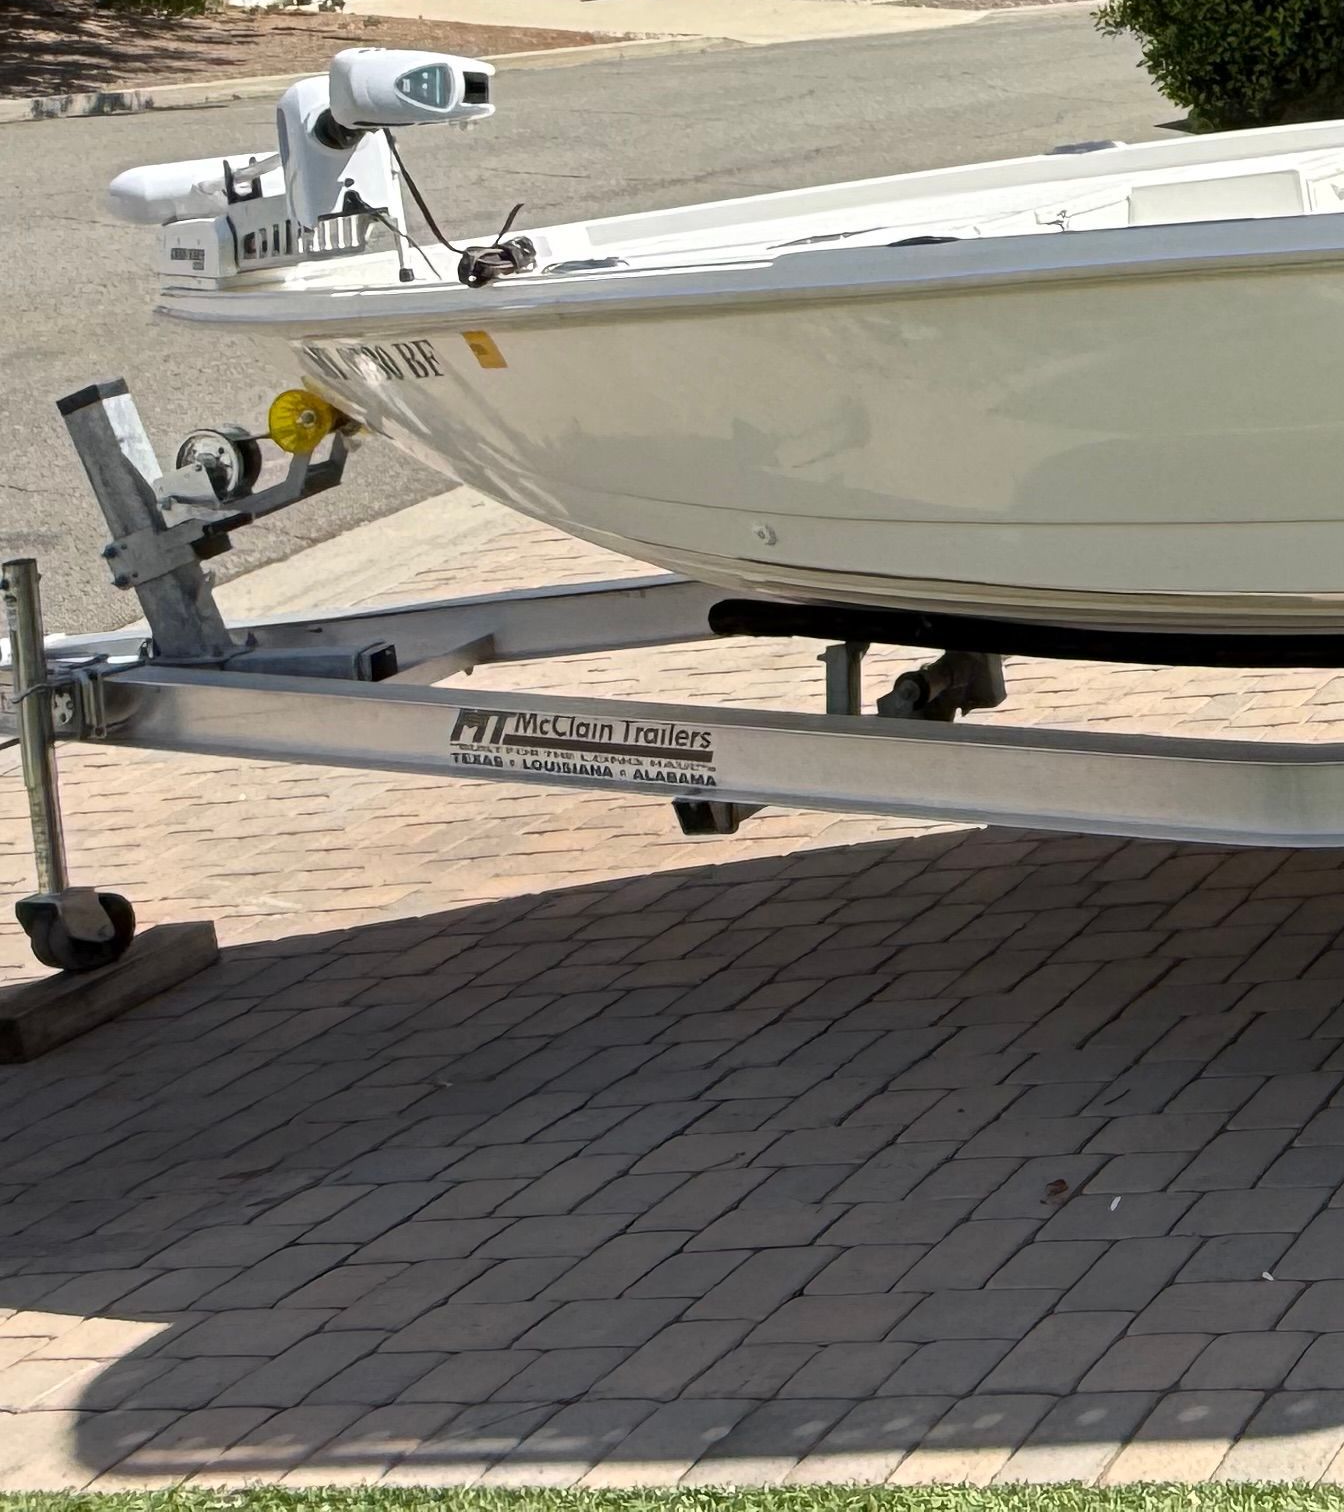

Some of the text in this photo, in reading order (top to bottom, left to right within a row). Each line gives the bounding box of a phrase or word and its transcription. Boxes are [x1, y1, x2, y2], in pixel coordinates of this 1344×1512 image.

[514, 712, 712, 749] McClain Trailers
[450, 753, 717, 786] TEXAS LOUISIANA ALABAMA
